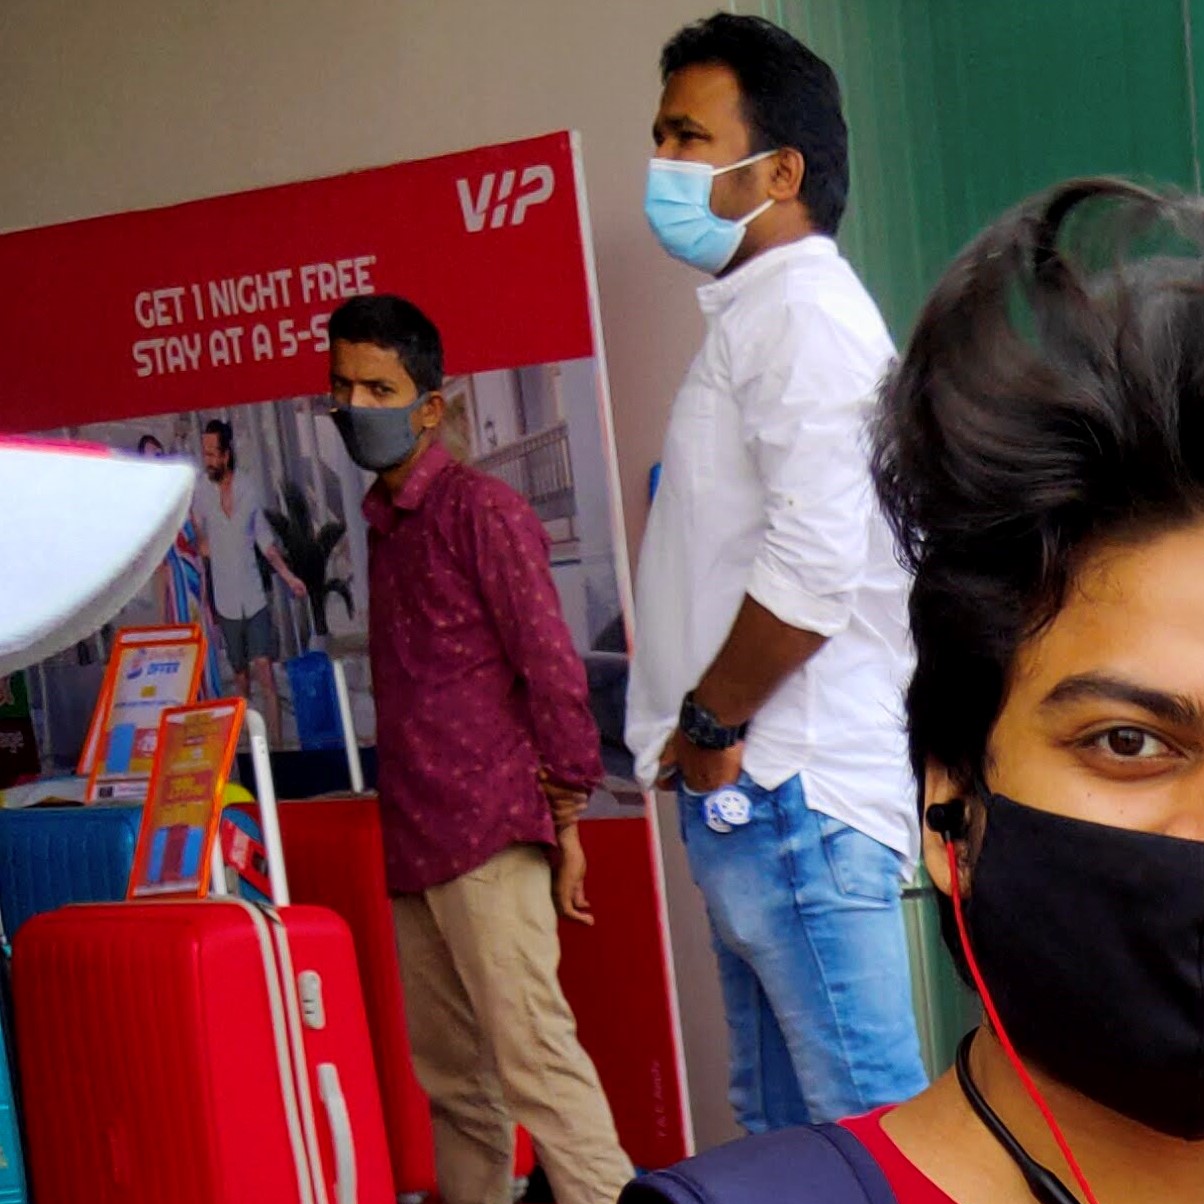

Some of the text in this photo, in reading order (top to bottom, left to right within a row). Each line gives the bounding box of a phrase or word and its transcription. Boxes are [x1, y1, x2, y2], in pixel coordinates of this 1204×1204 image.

[455, 163, 555, 233] VIP
[135, 287, 185, 329] GET
[209, 268, 292, 318] NIGHT
[132, 312, 331, 378] STAY AT A 5-S
